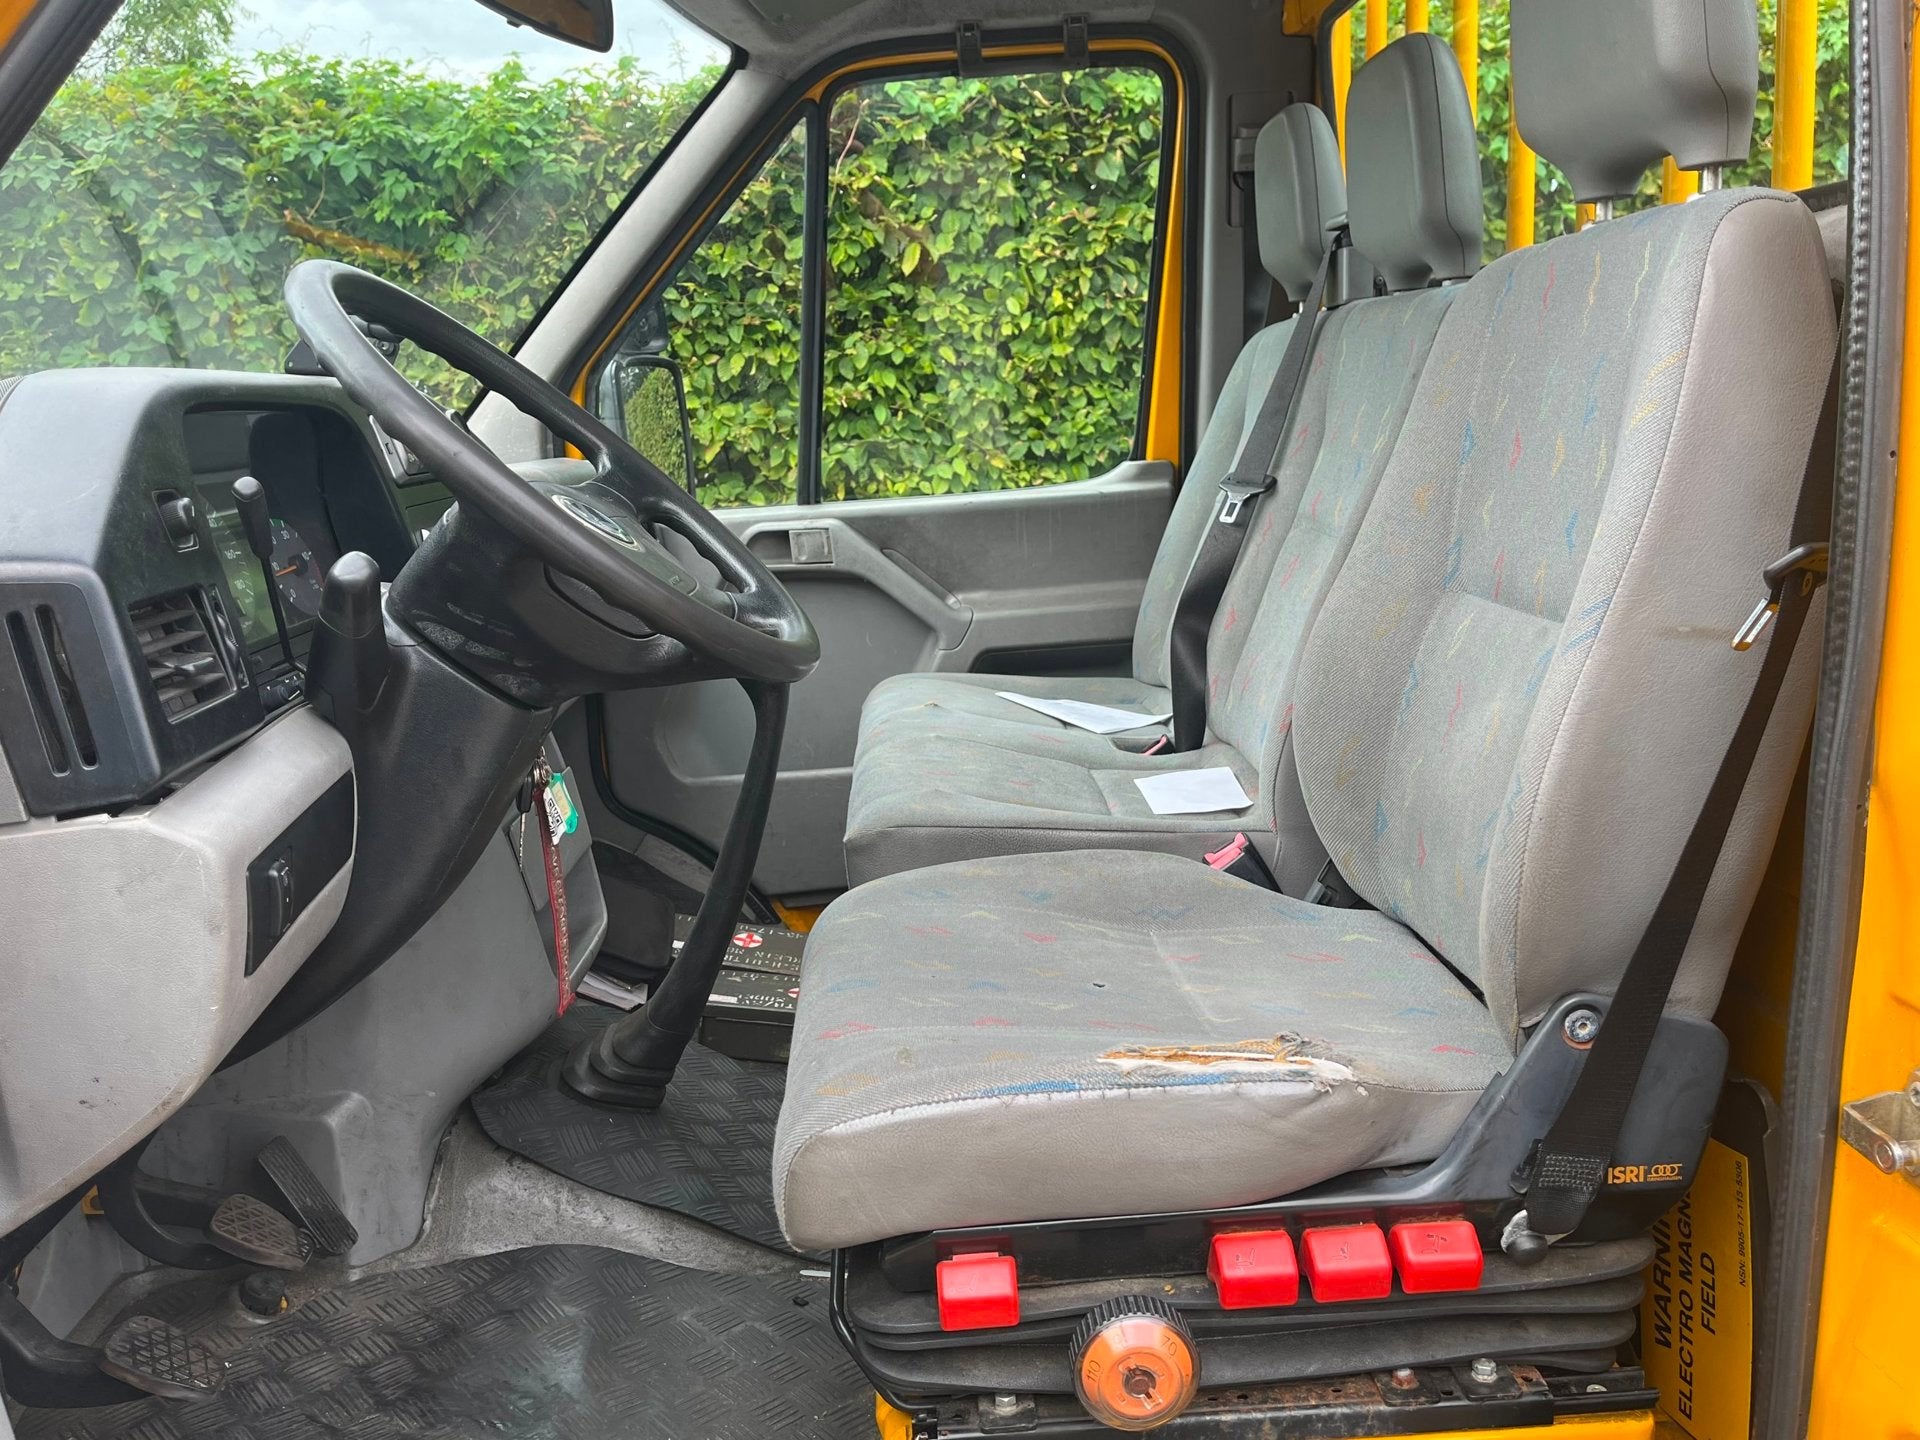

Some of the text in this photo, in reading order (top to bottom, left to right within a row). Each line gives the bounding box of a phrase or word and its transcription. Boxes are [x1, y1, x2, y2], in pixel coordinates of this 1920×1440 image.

[1607, 1165, 1645, 1185] ISRI
[1651, 1218, 1672, 1349] WARNI
[1677, 1191, 1694, 1421] ELECTRO MAGN
[1700, 1252, 1716, 1336] FIELD
[1161, 1335, 1178, 1357] 70
